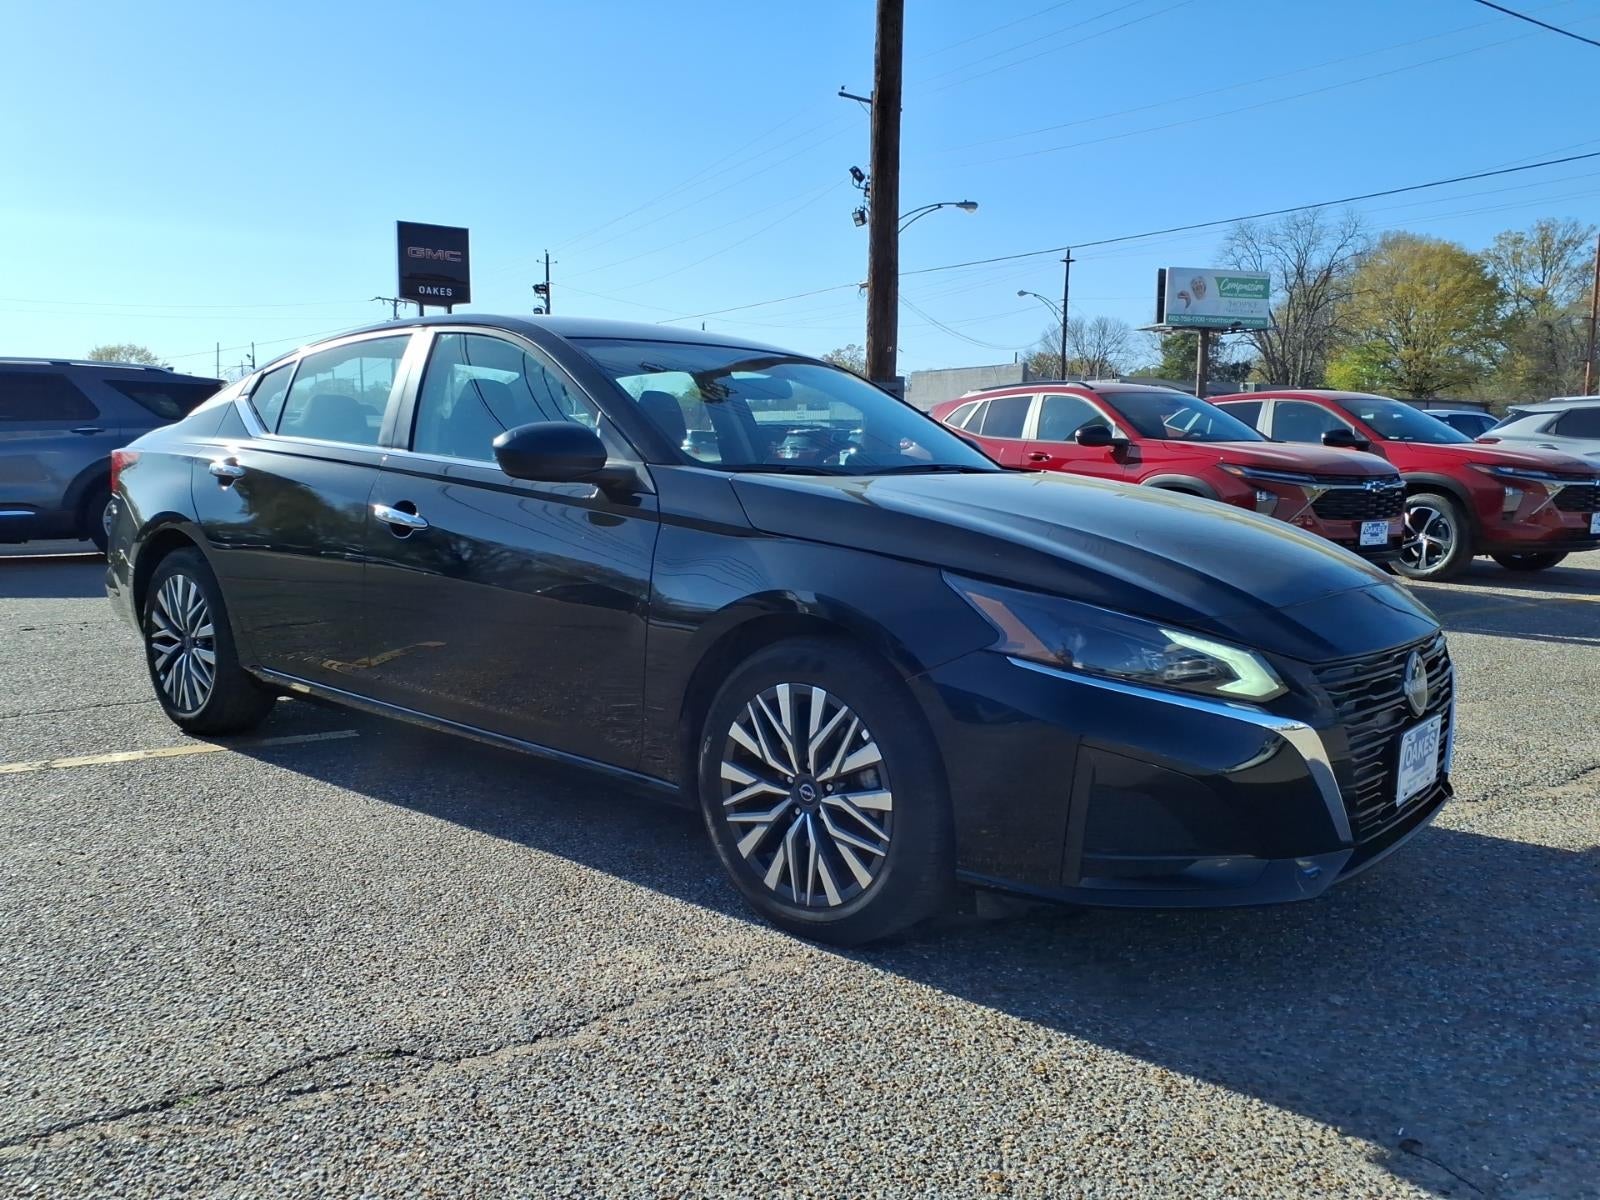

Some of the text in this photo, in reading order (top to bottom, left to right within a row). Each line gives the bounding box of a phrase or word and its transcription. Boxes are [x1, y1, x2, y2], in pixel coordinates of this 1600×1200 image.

[408, 247, 462, 262] GMC
[419, 285, 453, 297] OAKES
[1405, 732, 1435, 767] OAKES
